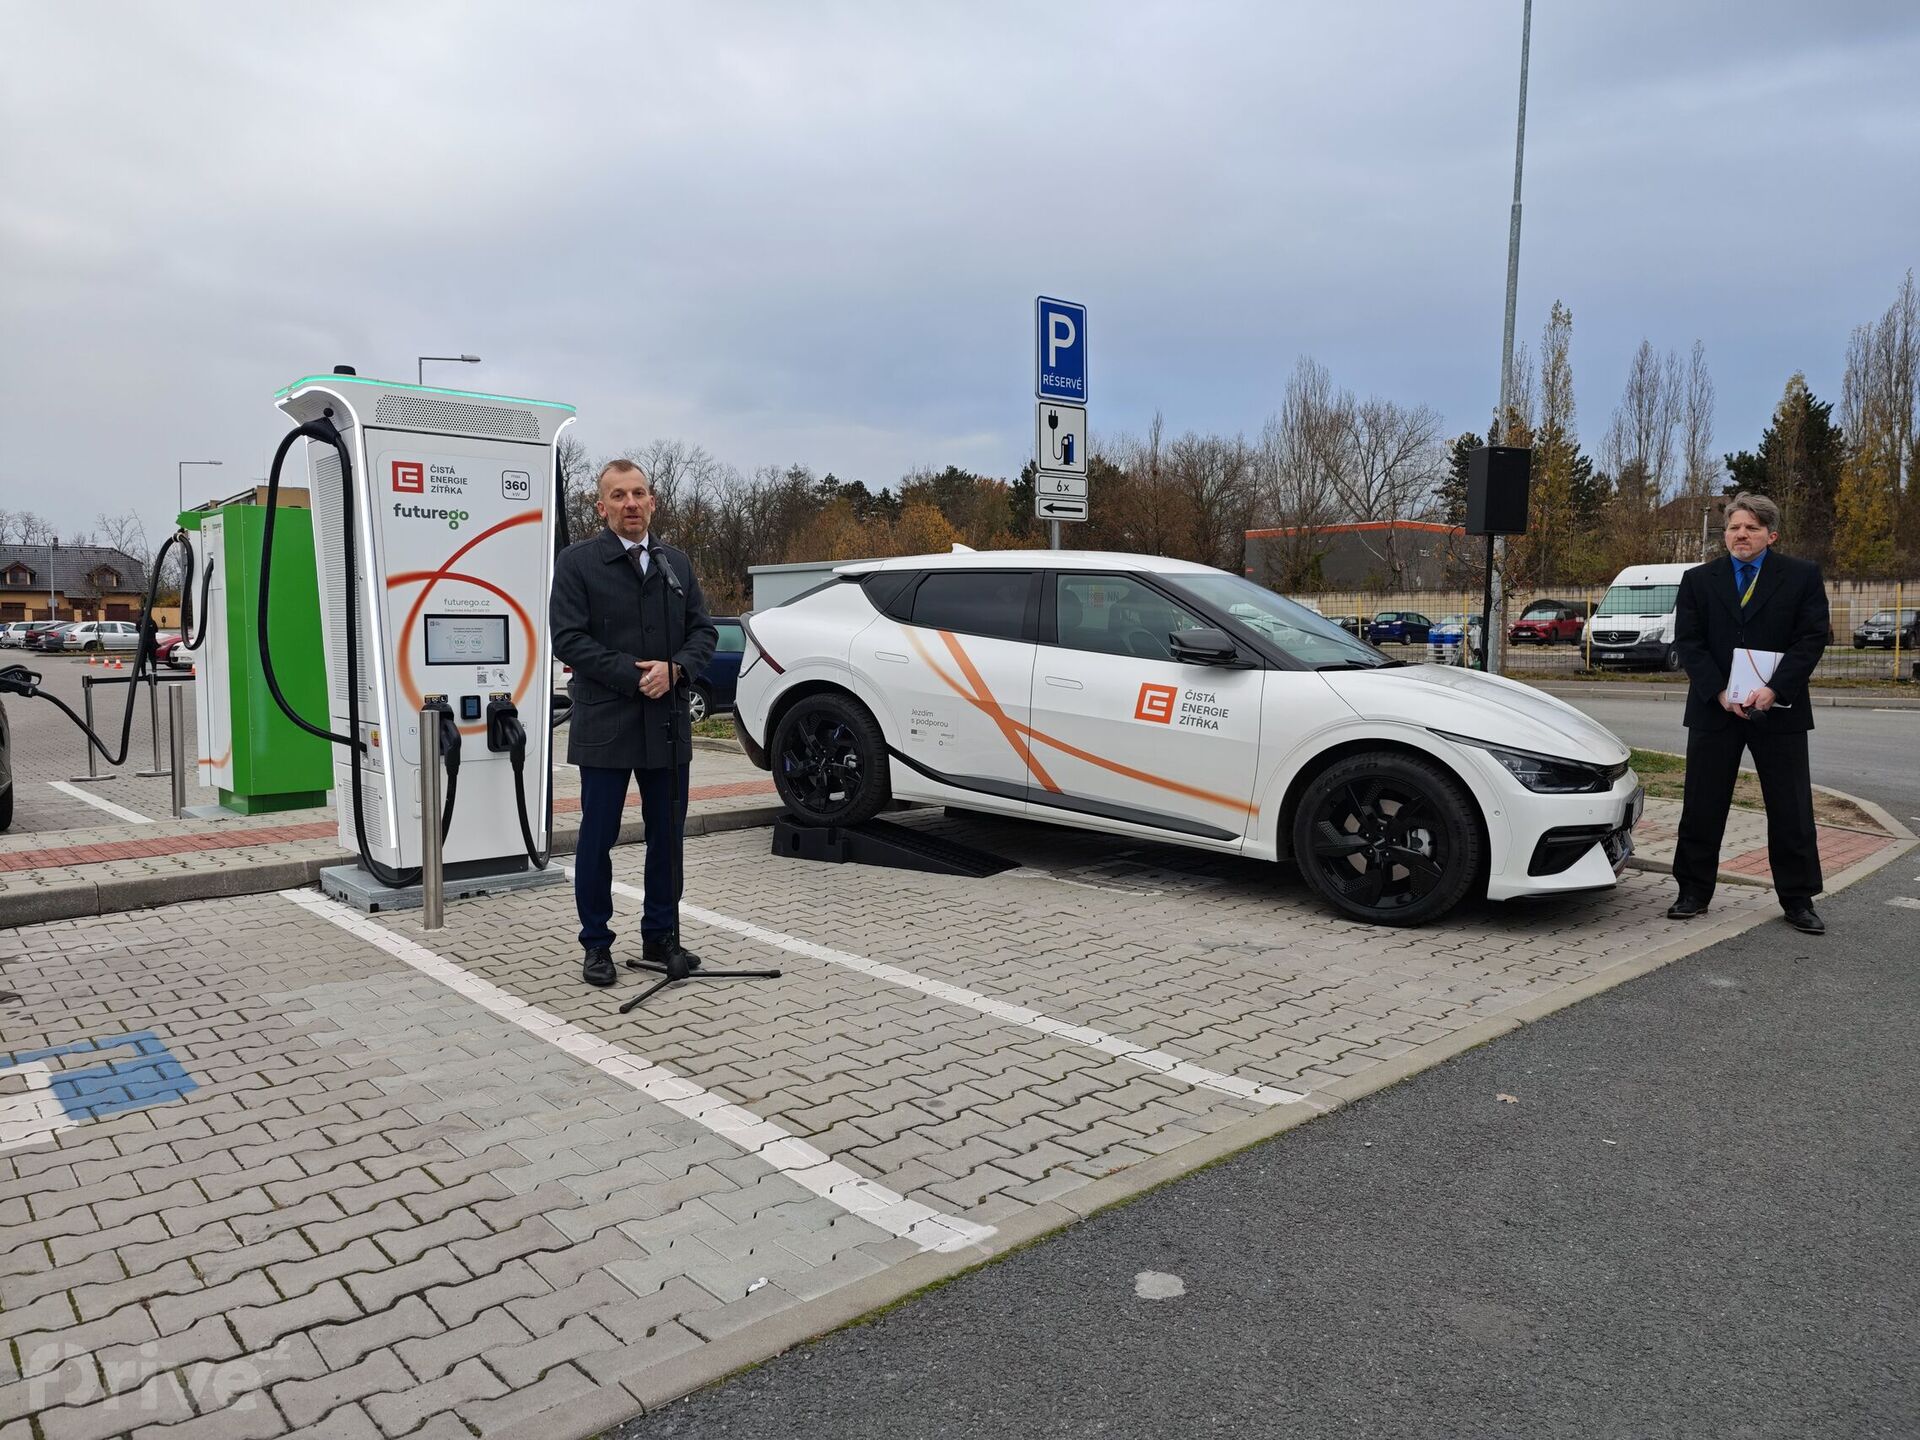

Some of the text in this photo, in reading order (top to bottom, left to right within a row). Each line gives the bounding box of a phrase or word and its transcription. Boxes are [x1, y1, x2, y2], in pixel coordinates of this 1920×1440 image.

[1048, 311, 1076, 367] P
[1042, 372, 1082, 390] RÉSERVÉ
[430, 464, 455, 474] ČISTÁ
[430, 475, 468, 486] ENERGIE
[504, 480, 527, 491] 360
[430, 485, 463, 495] ZÍTŘKA
[393, 503, 469, 530] futurego
[1185, 690, 1216, 703] ČISTÁ
[1182, 703, 1229, 718] ENERGIE
[916, 718, 949, 728] podporou
[1179, 715, 1219, 729] ZÍTŘKA
